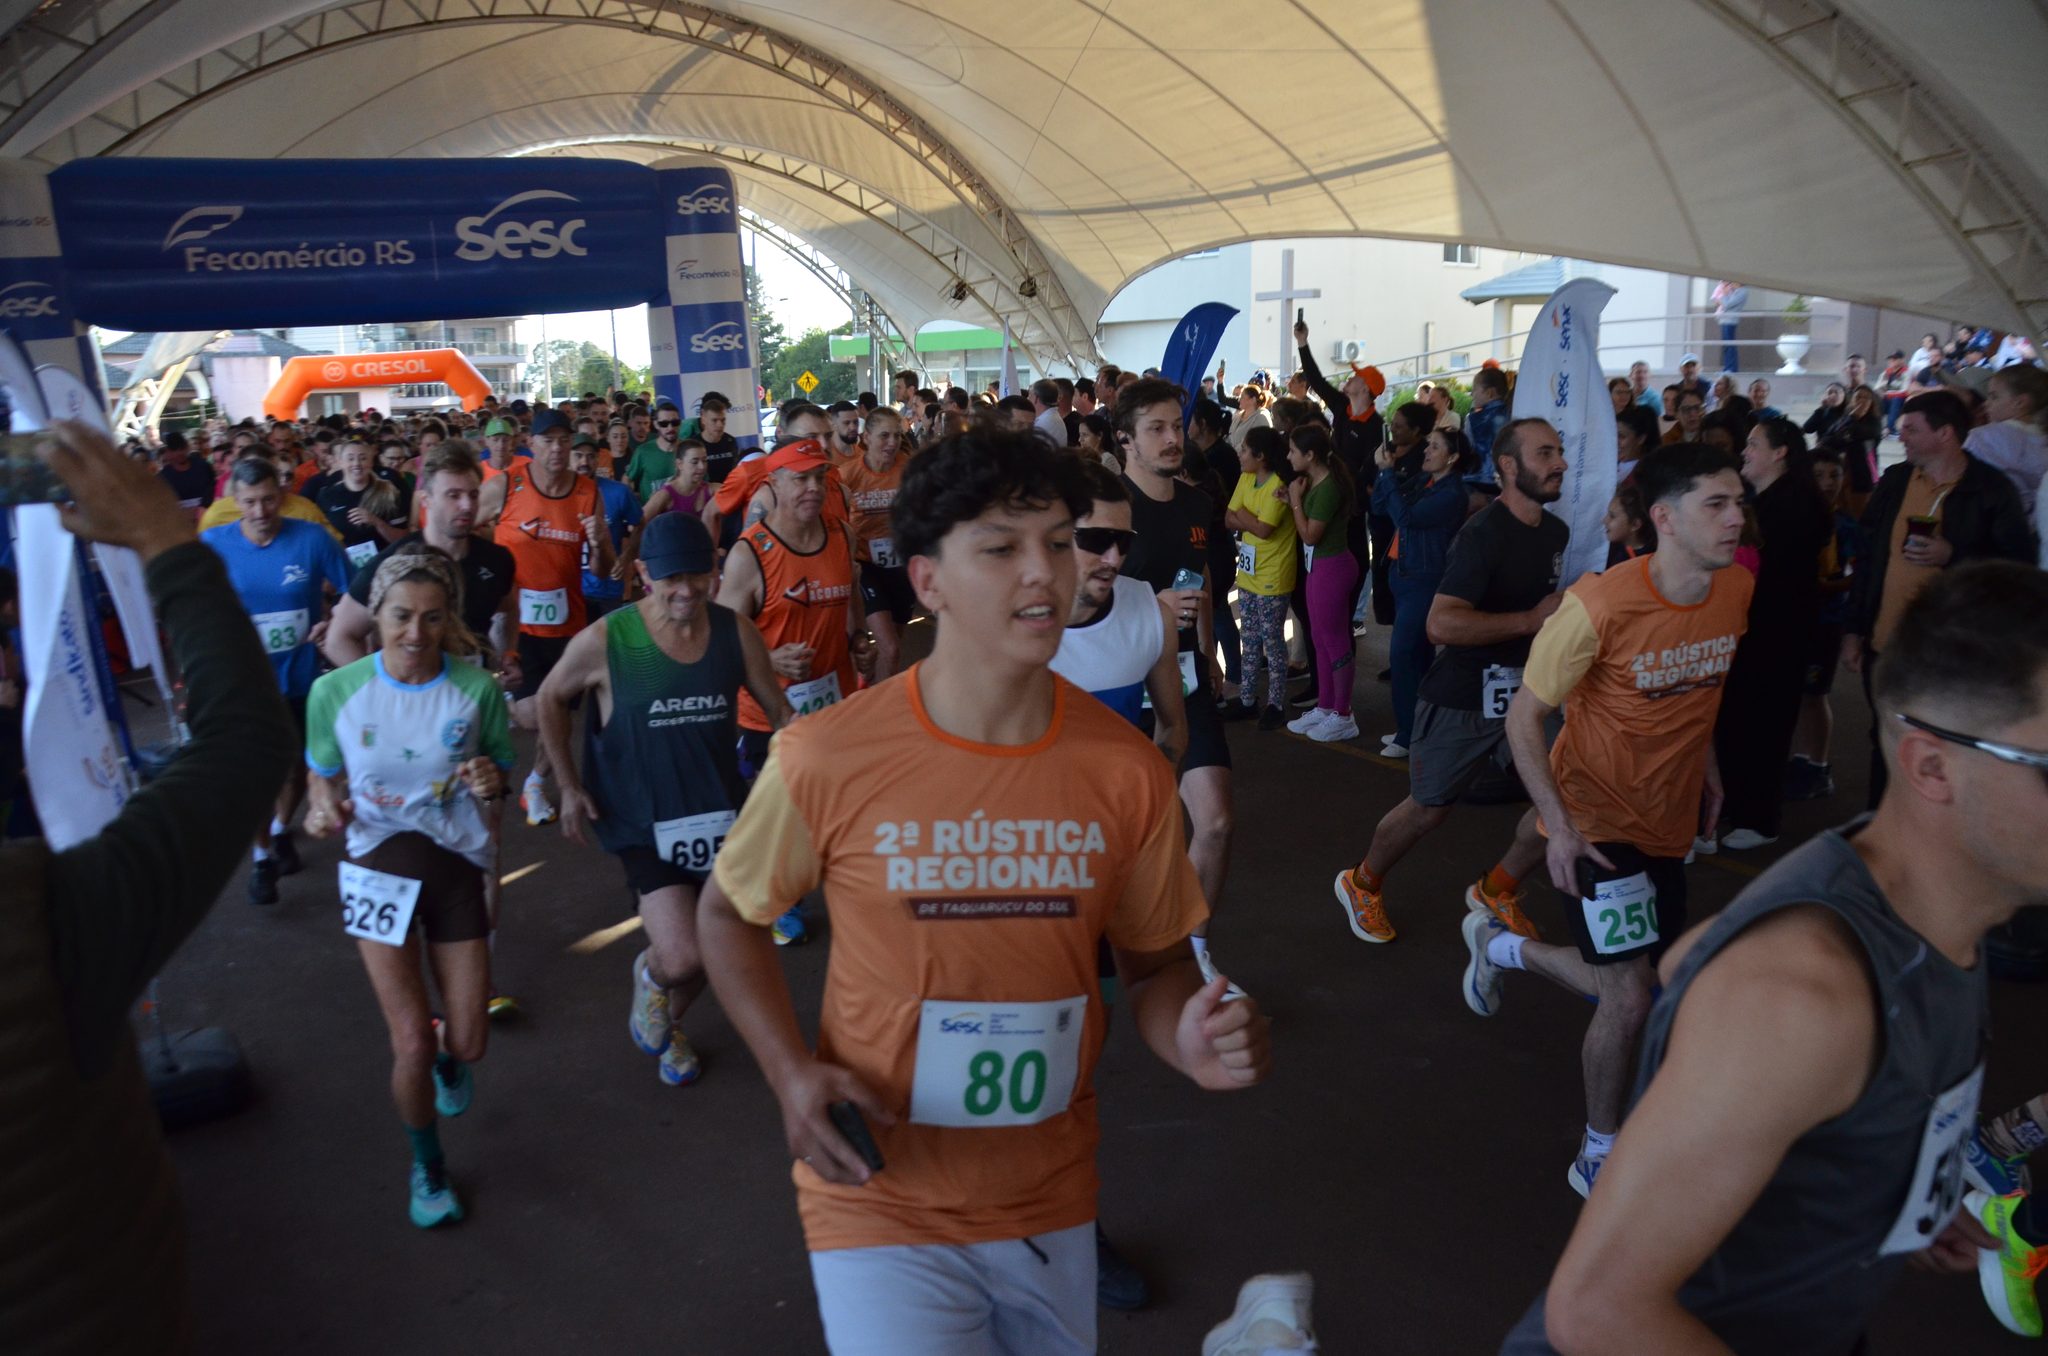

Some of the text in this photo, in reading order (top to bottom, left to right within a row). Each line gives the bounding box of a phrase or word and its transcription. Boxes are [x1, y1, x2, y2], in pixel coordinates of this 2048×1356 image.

[676, 192, 731, 215] Sesc
[454, 212, 588, 262] Sesc
[184, 239, 416, 272] Fecomércio RS
[680, 267, 731, 281] Fecomércio
[0, 295, 60, 318] esc
[690, 331, 744, 353] Sesc
[352, 359, 432, 378] CRESOL
[1555, 371, 1569, 407] Sesc
[532, 604, 557, 622] 70
[270, 626, 297, 649] 83
[648, 694, 728, 714] ARENA
[874, 809, 1106, 854] 2ª RÚSTICA
[886, 855, 1095, 891] REGIONAL
[918, 901, 1069, 915] DE TAQUARUÇU DO SUL
[939, 1016, 984, 1035] Sesc
[964, 1050, 1047, 1116] 80
